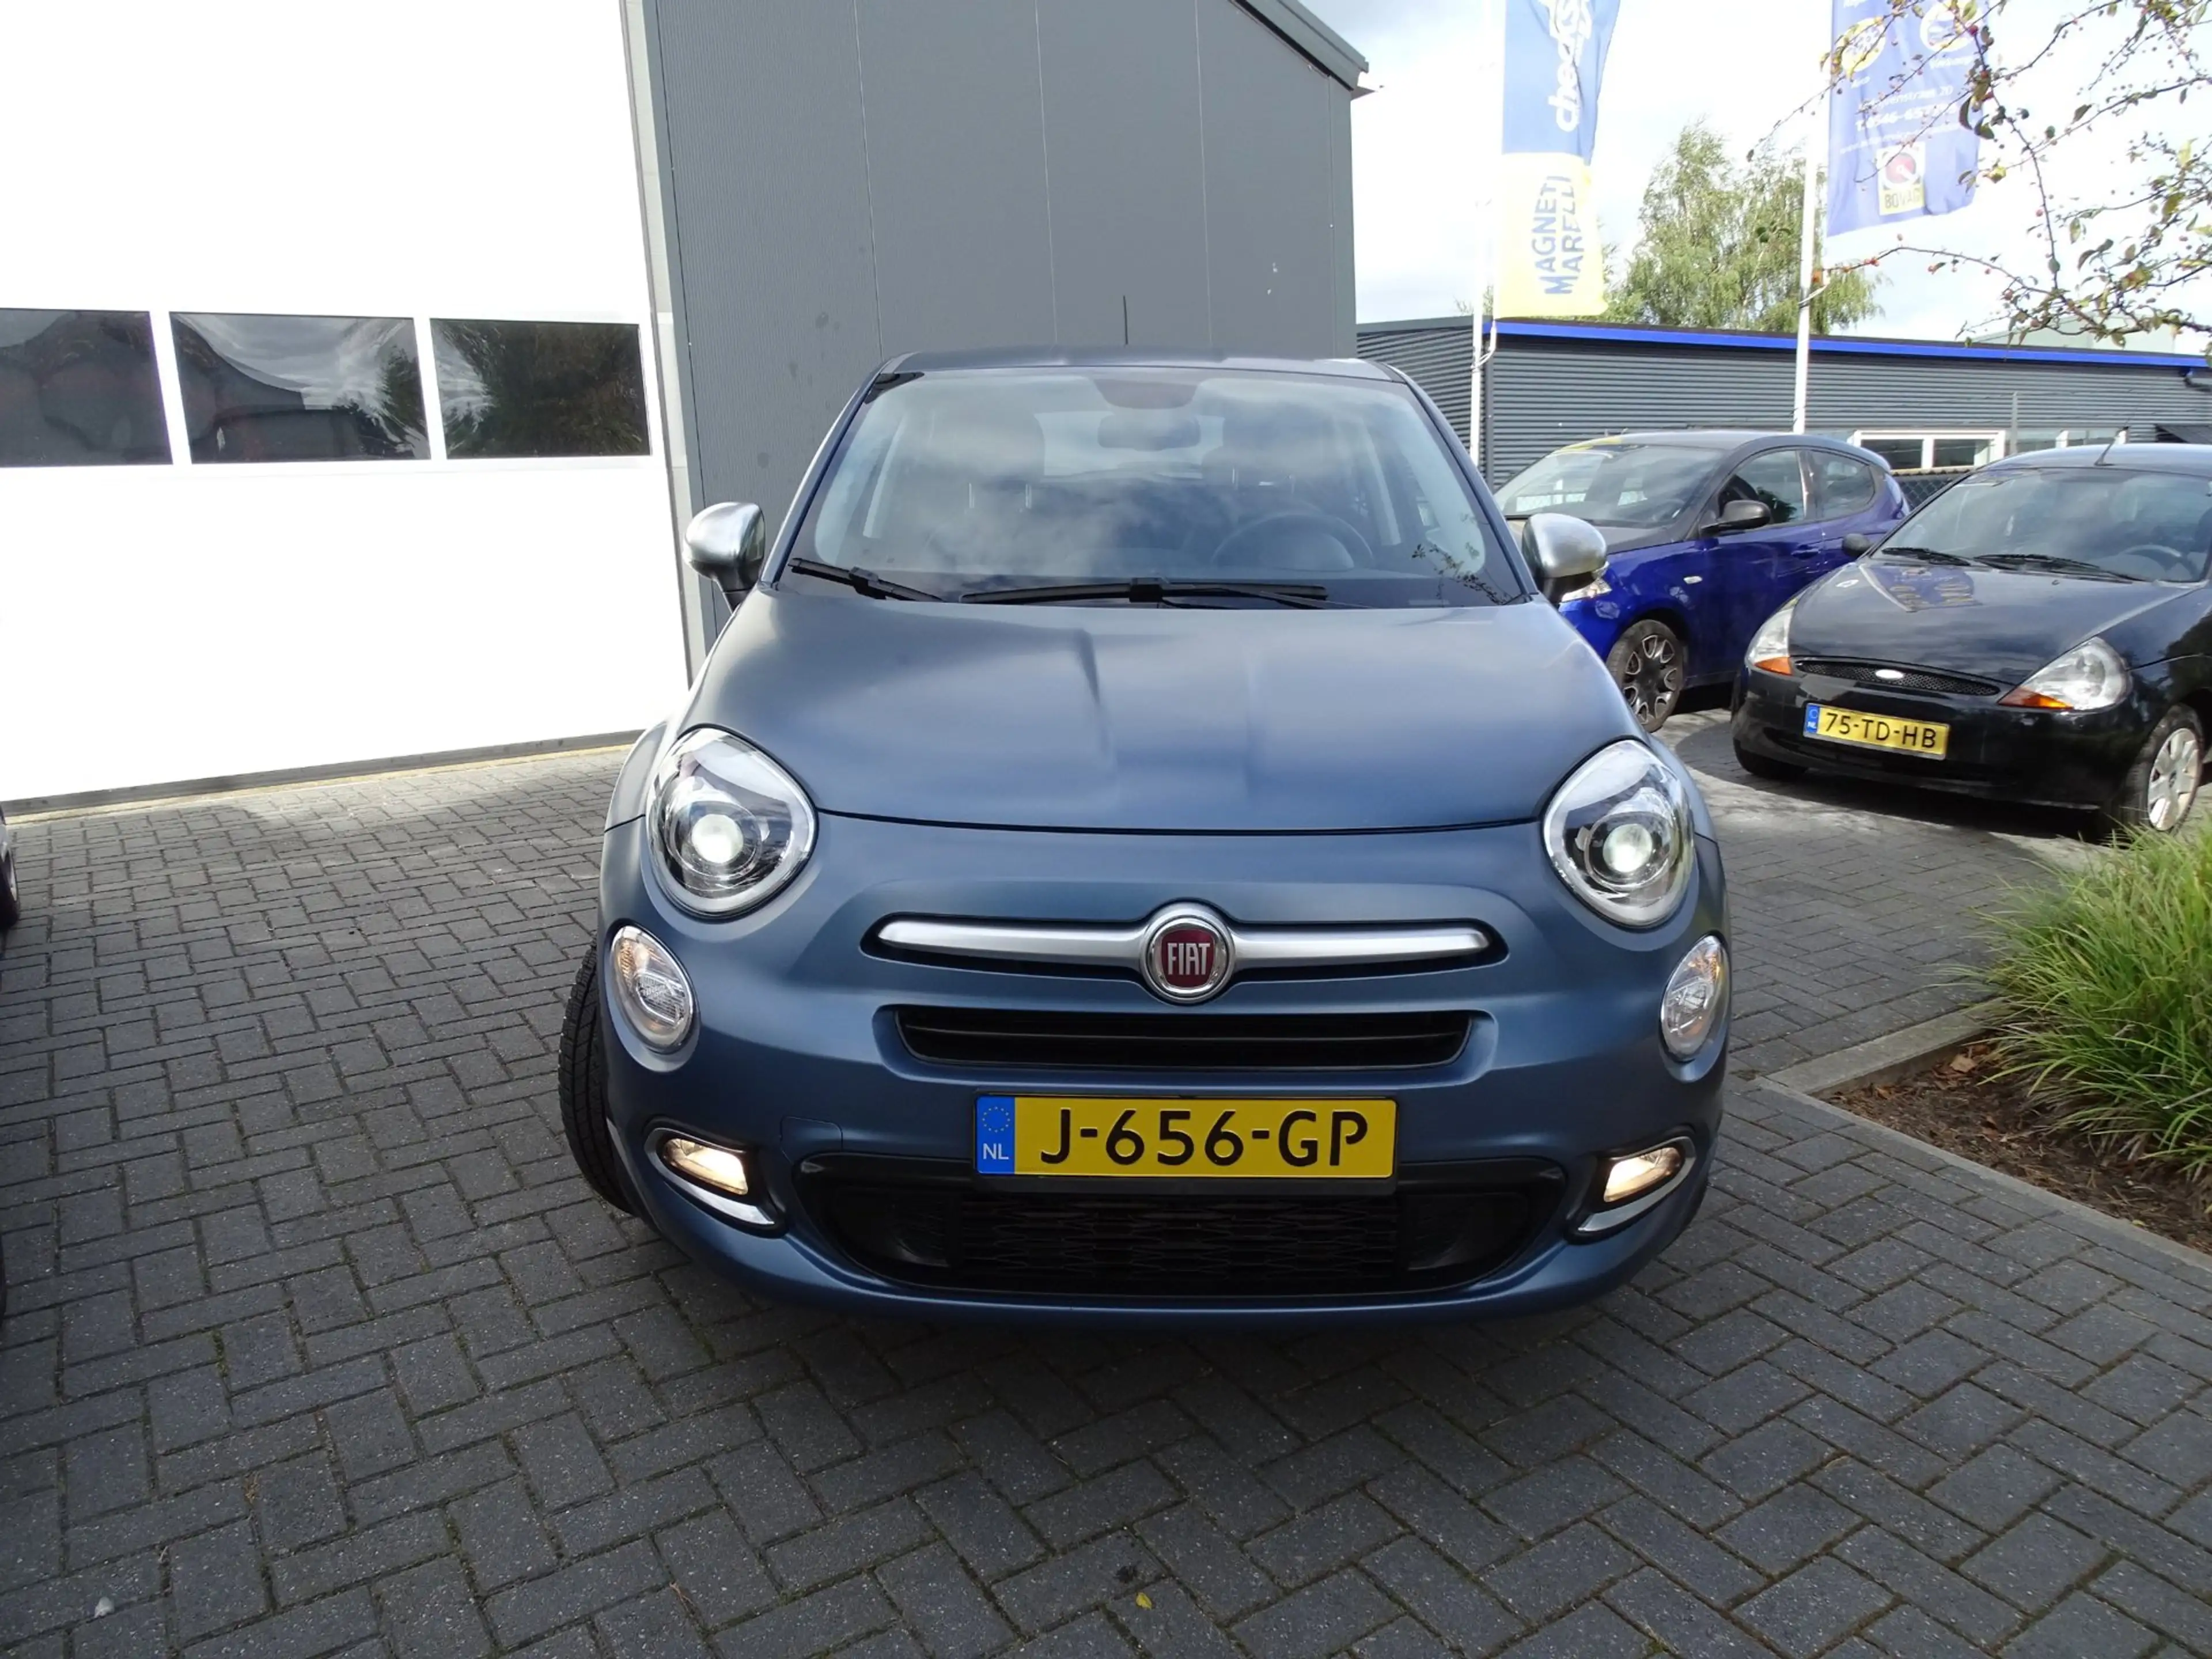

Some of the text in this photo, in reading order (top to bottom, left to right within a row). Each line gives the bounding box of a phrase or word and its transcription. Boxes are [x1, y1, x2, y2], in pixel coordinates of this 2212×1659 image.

[1531, 176, 1562, 294] MAGNETI
[1553, 176, 1584, 294] MARELLI
[1825, 712, 1937, 749] 75-TD-HB
[1167, 942, 1210, 976] FIAT
[982, 1107, 1369, 1167] NL J-656-GP
